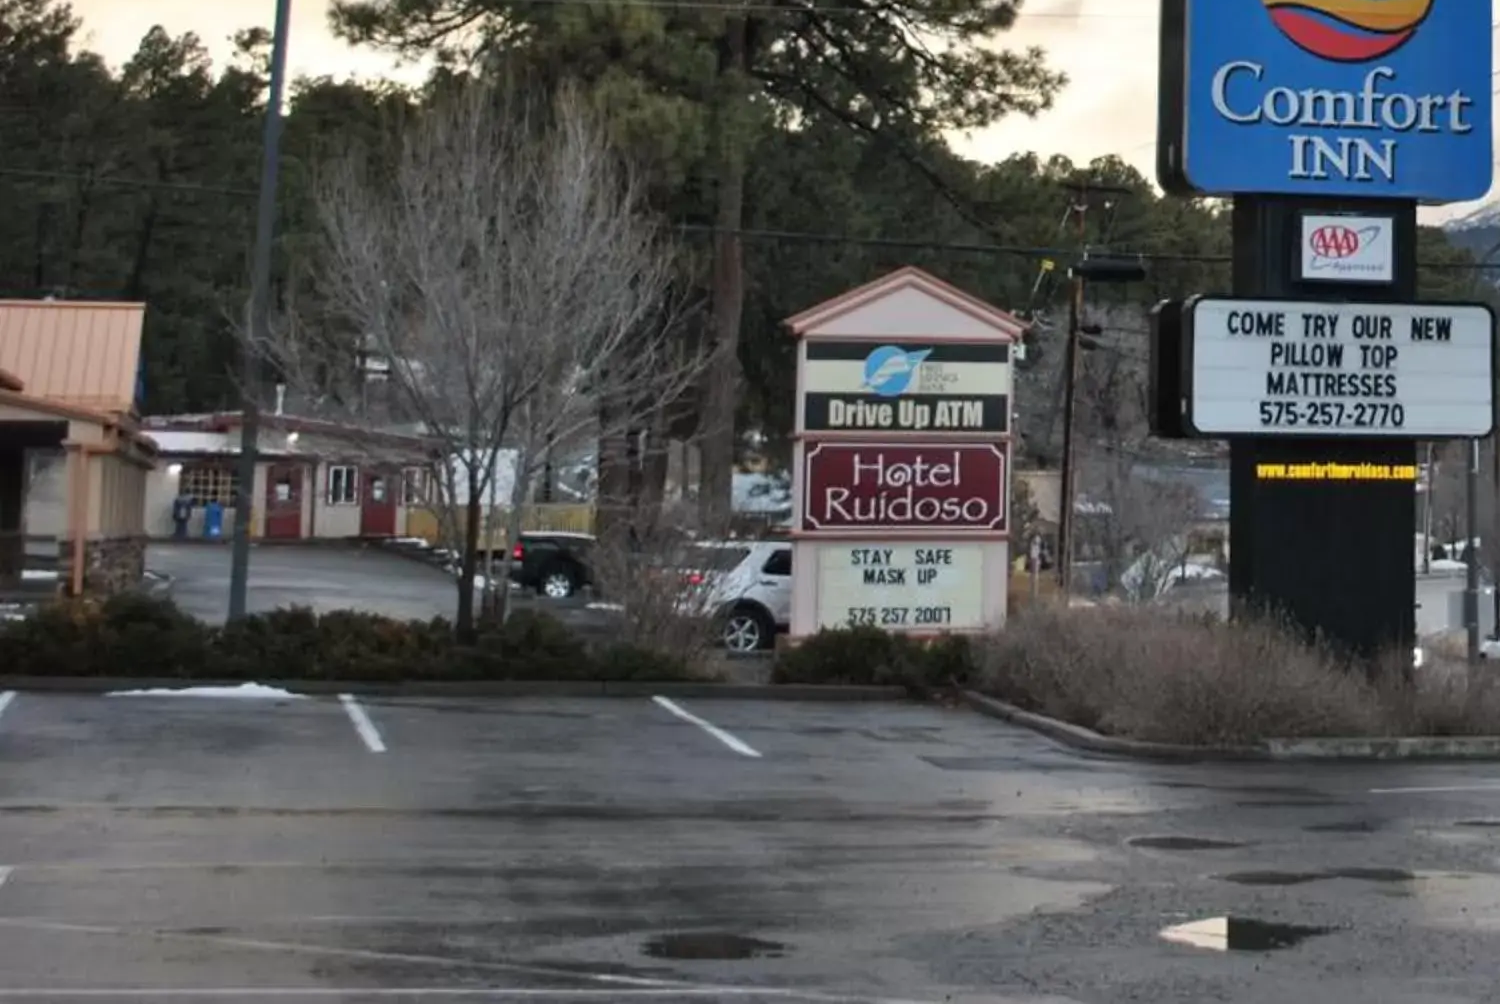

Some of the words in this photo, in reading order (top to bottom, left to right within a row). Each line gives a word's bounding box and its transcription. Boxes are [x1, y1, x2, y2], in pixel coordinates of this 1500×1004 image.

[1211, 60, 1472, 132] Comfort
[1288, 134, 1396, 180] INN
[1313, 224, 1357, 258] AAA
[1227, 311, 1285, 337] COME
[1302, 313, 1339, 338] TRY
[1352, 315, 1393, 339] OUR
[1411, 317, 1452, 341] NEW
[1270, 343, 1344, 369] PILLOW
[1360, 345, 1398, 369] TOP
[1266, 372, 1397, 397] MATTRESSES
[828, 399, 892, 428] Drive
[899, 400, 931, 430] Up
[934, 399, 984, 427] ATM
[1259, 402, 1405, 427] 575-257-2770
[852, 451, 961, 488] Hotel
[825, 486, 988, 522] Ruidoso
[851, 549, 893, 567] STAY
[915, 549, 952, 566] SAFE
[863, 569, 905, 586] MASK
[917, 569, 938, 586] UP
[848, 607, 876, 625] 575
[881, 607, 908, 625] 257
